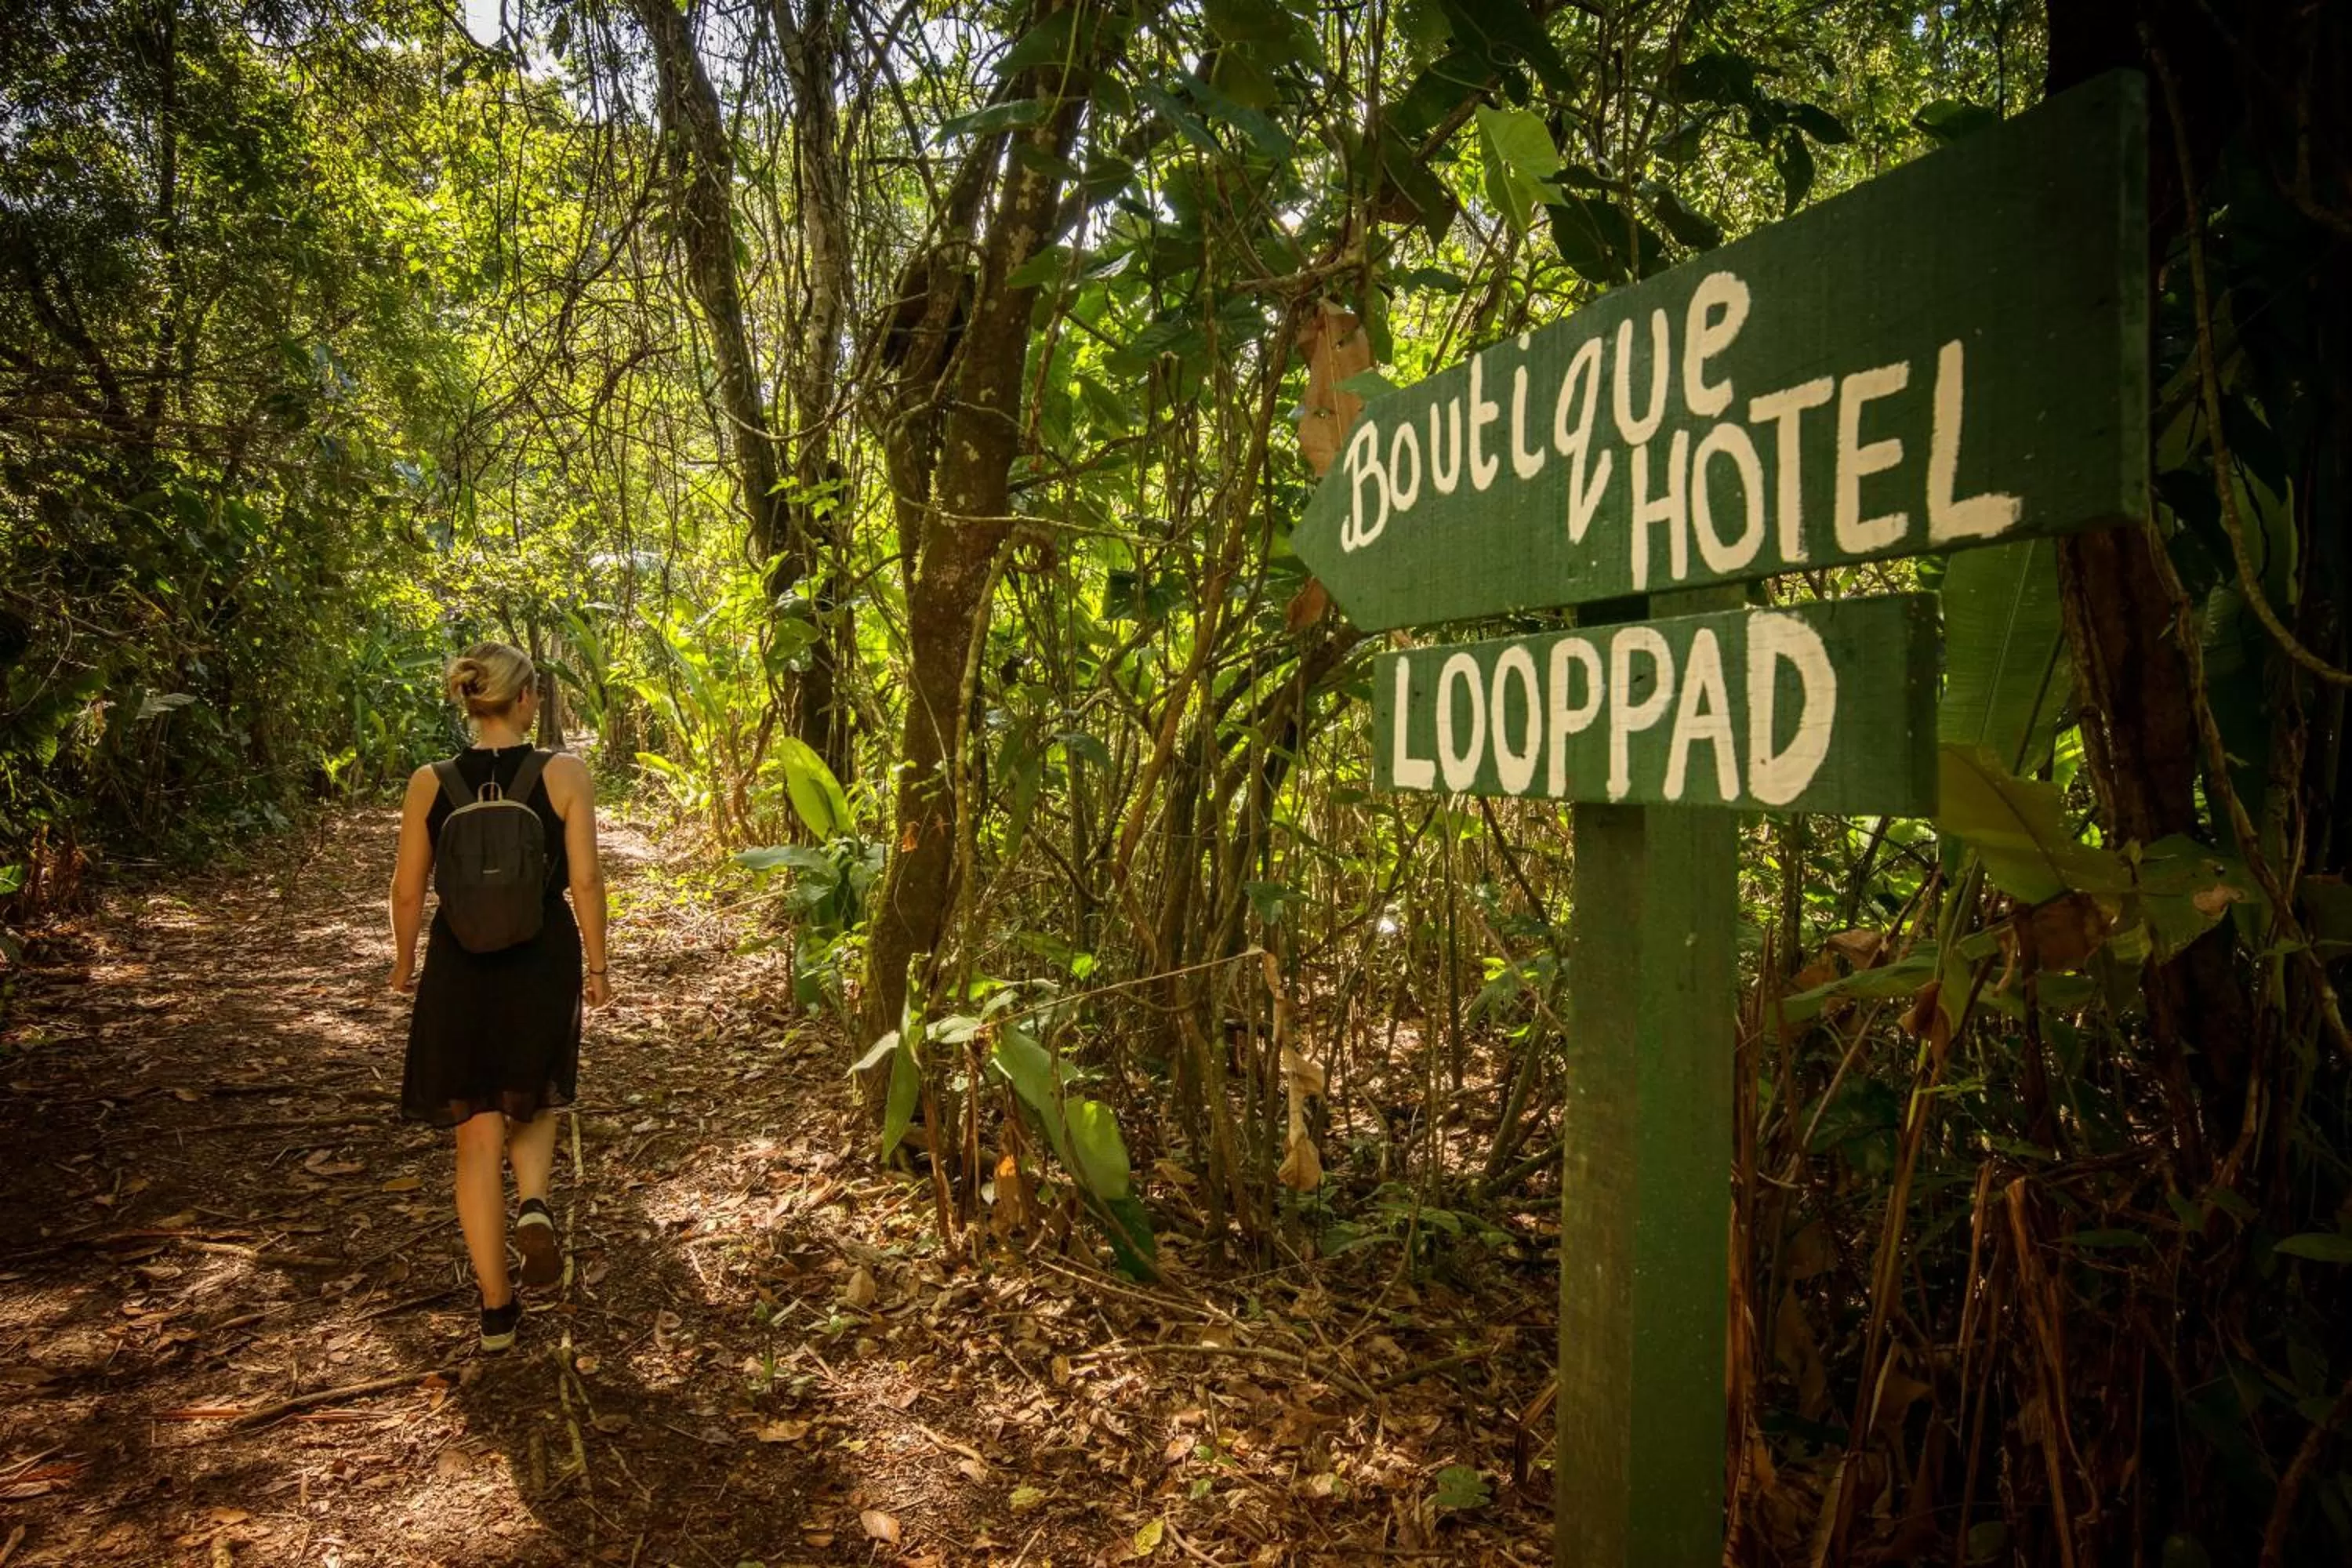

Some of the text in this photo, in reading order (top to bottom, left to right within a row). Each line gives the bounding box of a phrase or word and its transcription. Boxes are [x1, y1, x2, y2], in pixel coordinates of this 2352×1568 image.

[1340, 270, 1751, 553] Boutique
[1631, 339, 2022, 590] HOTEL
[1392, 609, 1837, 806] LOOPPAD
